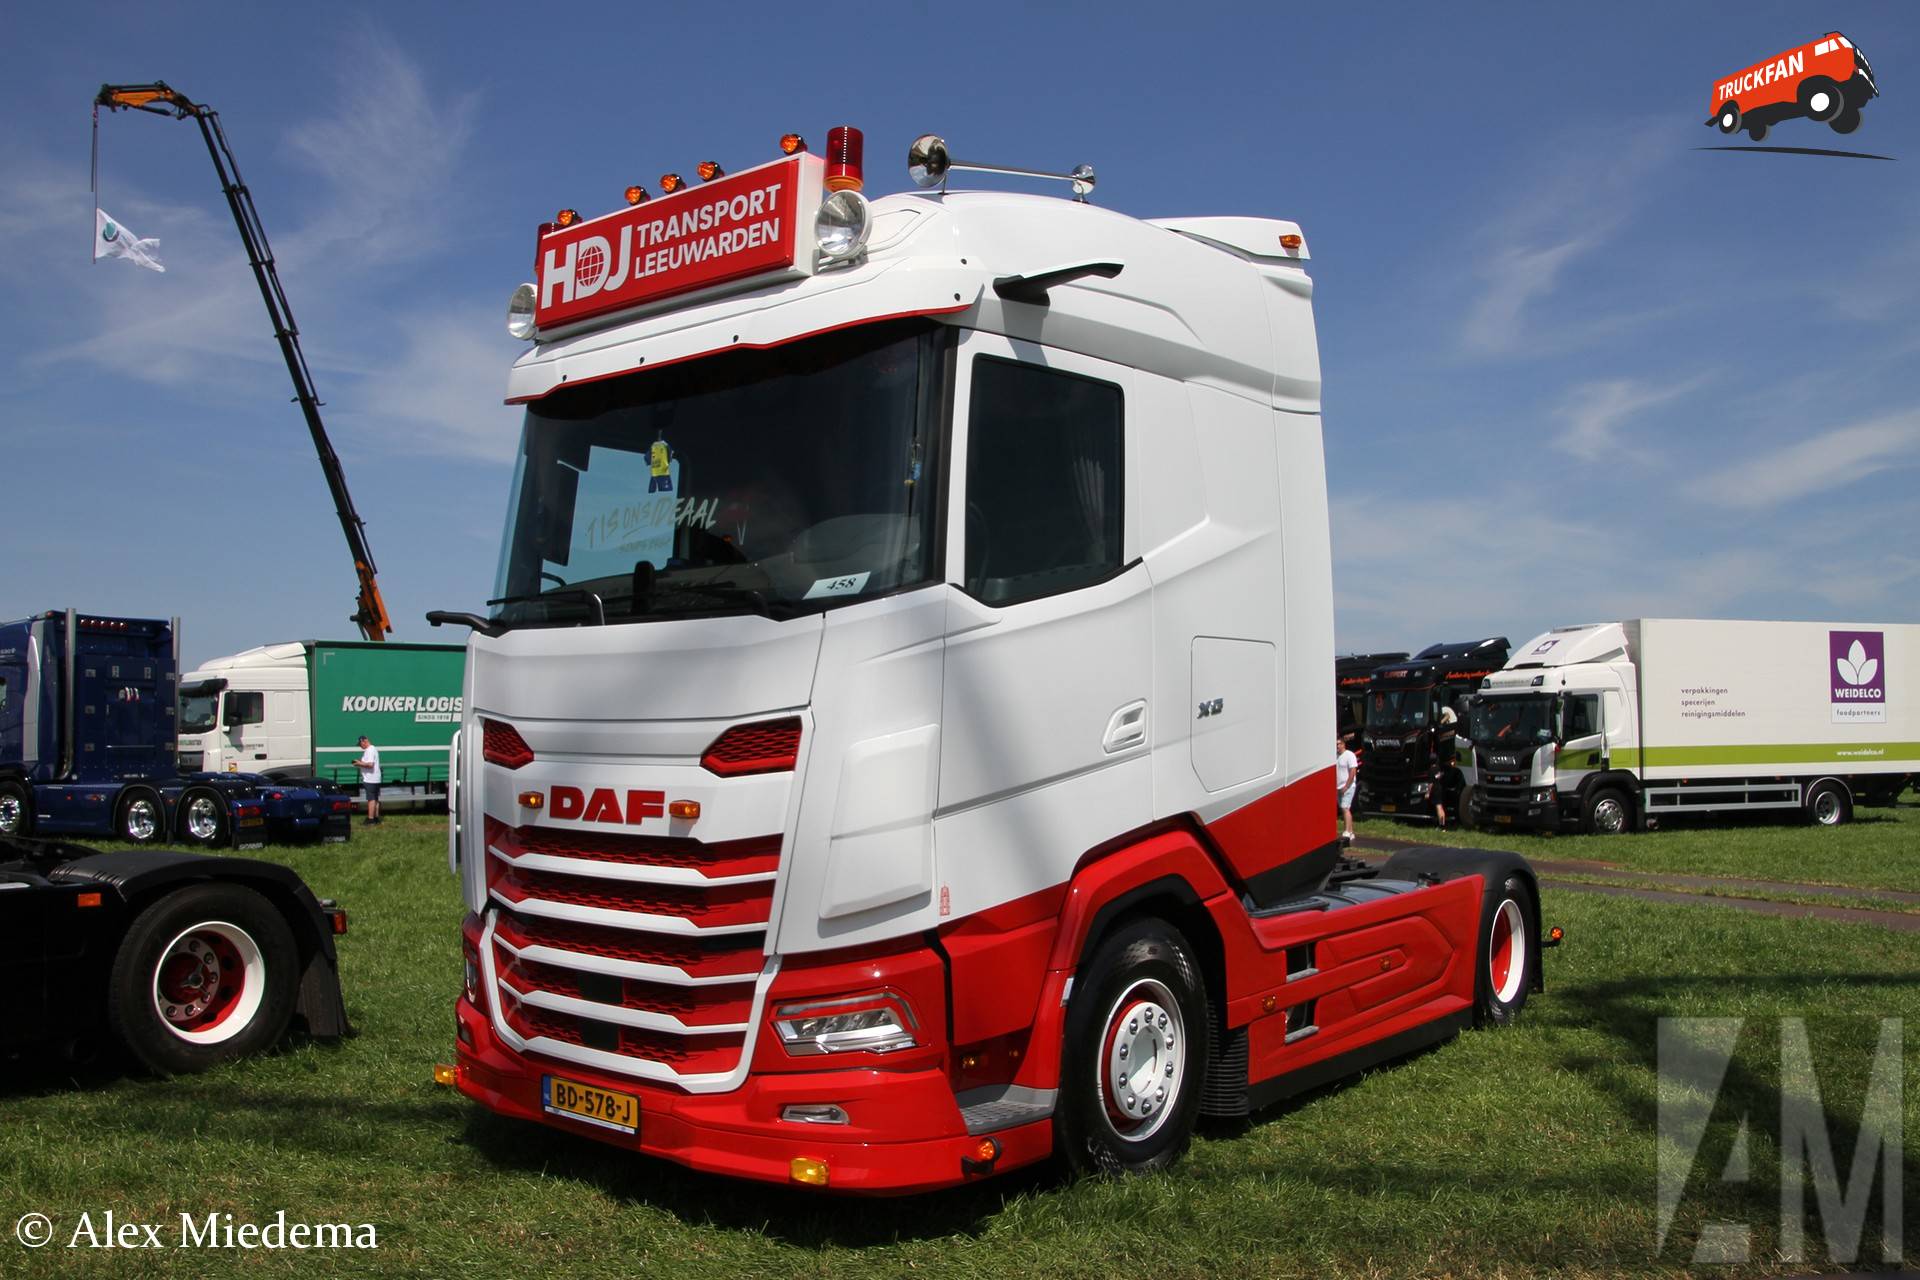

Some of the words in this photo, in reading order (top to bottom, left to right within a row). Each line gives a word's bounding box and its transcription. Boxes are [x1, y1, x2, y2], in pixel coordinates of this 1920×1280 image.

[636, 183, 782, 249] TRANSPORT
[634, 217, 780, 280] LEEUWARDEN
[541, 224, 633, 310] HDJ
[826, 577, 857, 590] 458
[1680, 686, 1728, 696] verpakkingen
[1834, 688, 1882, 699] WEIDELCO
[1680, 698, 1716, 707] specerijen
[1681, 710, 1746, 719] reinigingsmiddelen
[1836, 708, 1881, 718] foodpartners
[549, 785, 666, 826] DAF
[556, 1083, 631, 1123] BD-578-J
